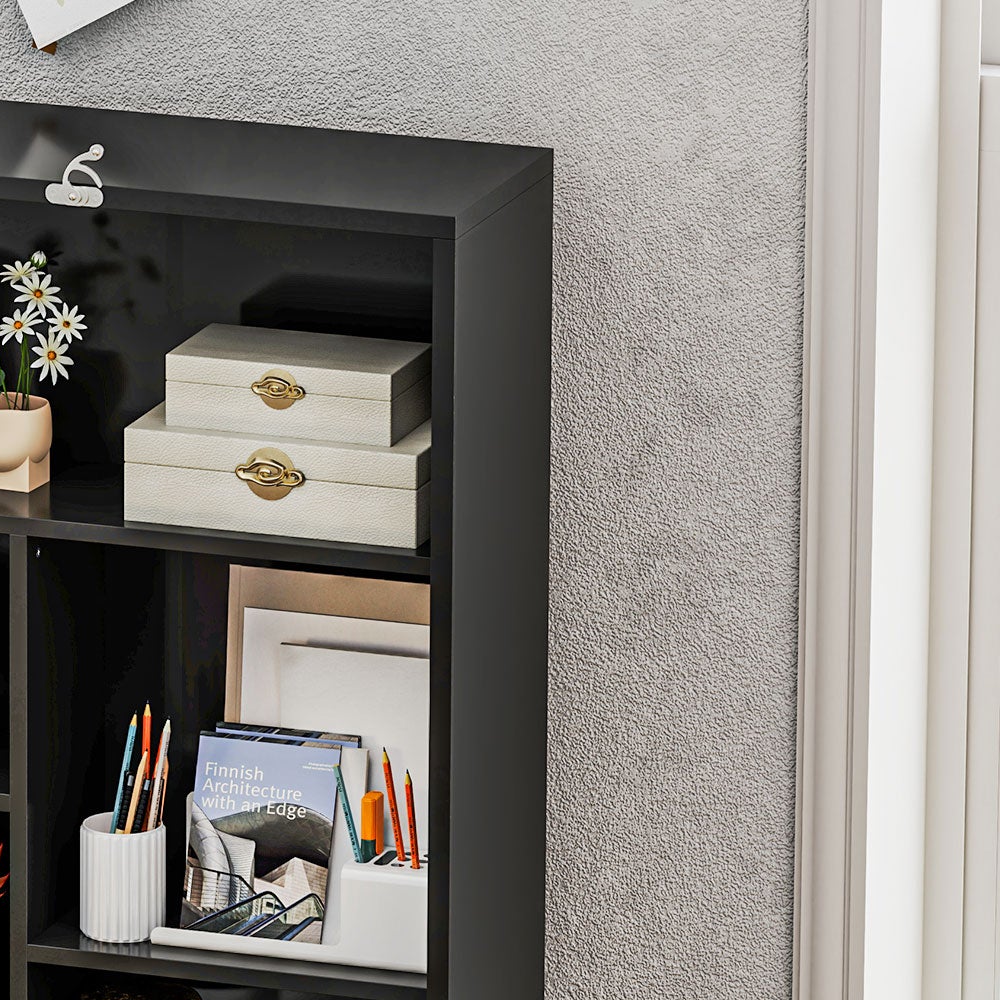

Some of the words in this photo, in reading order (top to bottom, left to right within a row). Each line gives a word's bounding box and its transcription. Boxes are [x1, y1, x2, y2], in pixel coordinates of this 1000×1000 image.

[204, 762, 264, 782] Finnish
[202, 779, 302, 801] Architecture
[201, 795, 235, 811] with
[241, 801, 261, 813] an
[267, 801, 307, 819] Edge
